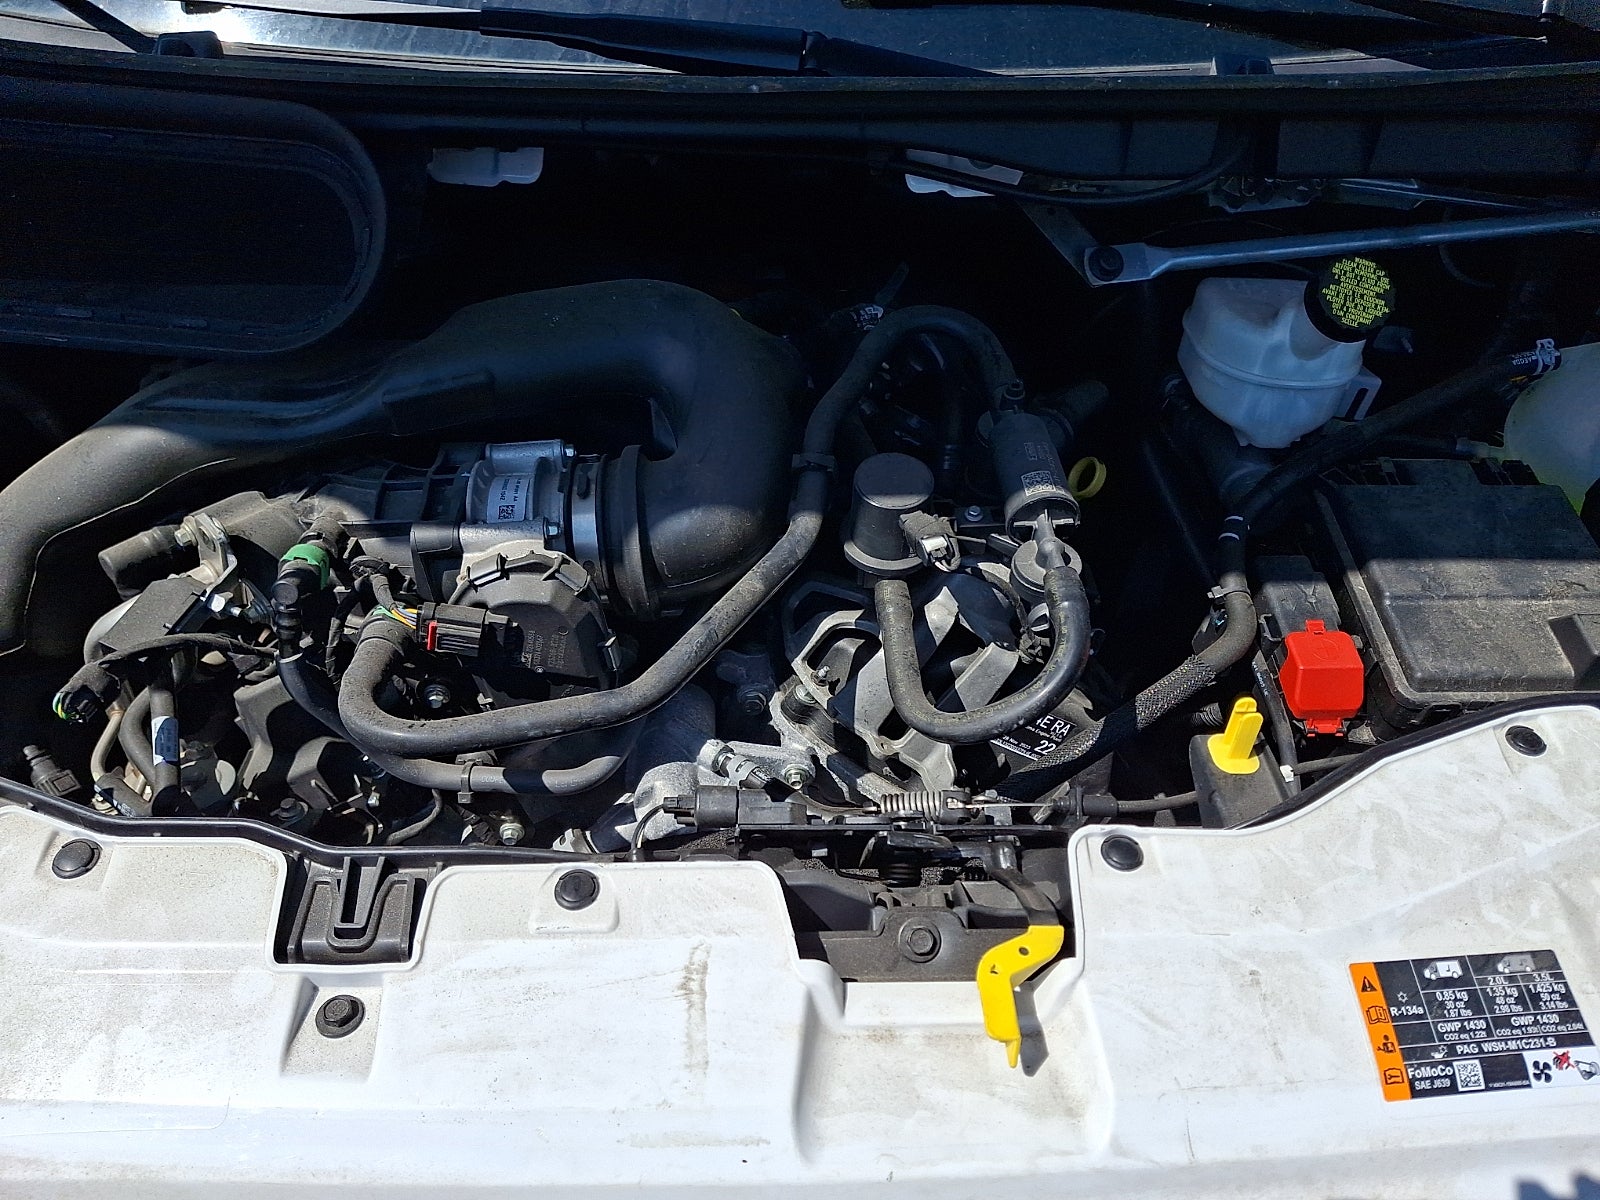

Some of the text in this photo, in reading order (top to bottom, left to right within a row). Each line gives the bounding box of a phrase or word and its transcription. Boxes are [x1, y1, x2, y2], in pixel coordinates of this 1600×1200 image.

[1050, 720, 1071, 736] RA
[1034, 740, 1056, 755] 22
[1488, 976, 1508, 985] 2.0L
[1533, 973, 1554, 982] 3.5L
[1486, 987, 1518, 997] 1.35 kg
[1529, 983, 1566, 993] 1.425 kg
[1436, 990, 1468, 1001] 0.85 kg
[1390, 1005, 1424, 1017] R-134a
[1494, 1005, 1510, 1013] 2.98
[1539, 1002, 1555, 1010] 3.14
[1444, 1009, 1472, 1018] 1.87 lbs
[1511, 1014, 1560, 1026] GWP 1430
[1437, 1021, 1486, 1032] GWP 1430
[1496, 1028, 1511, 1036] CO2
[1456, 1037, 1556, 1055] PAG WSH-M1C231-B
[1408, 1064, 1454, 1079] FoMoCo
[1414, 1079, 1450, 1090] SAE J639
